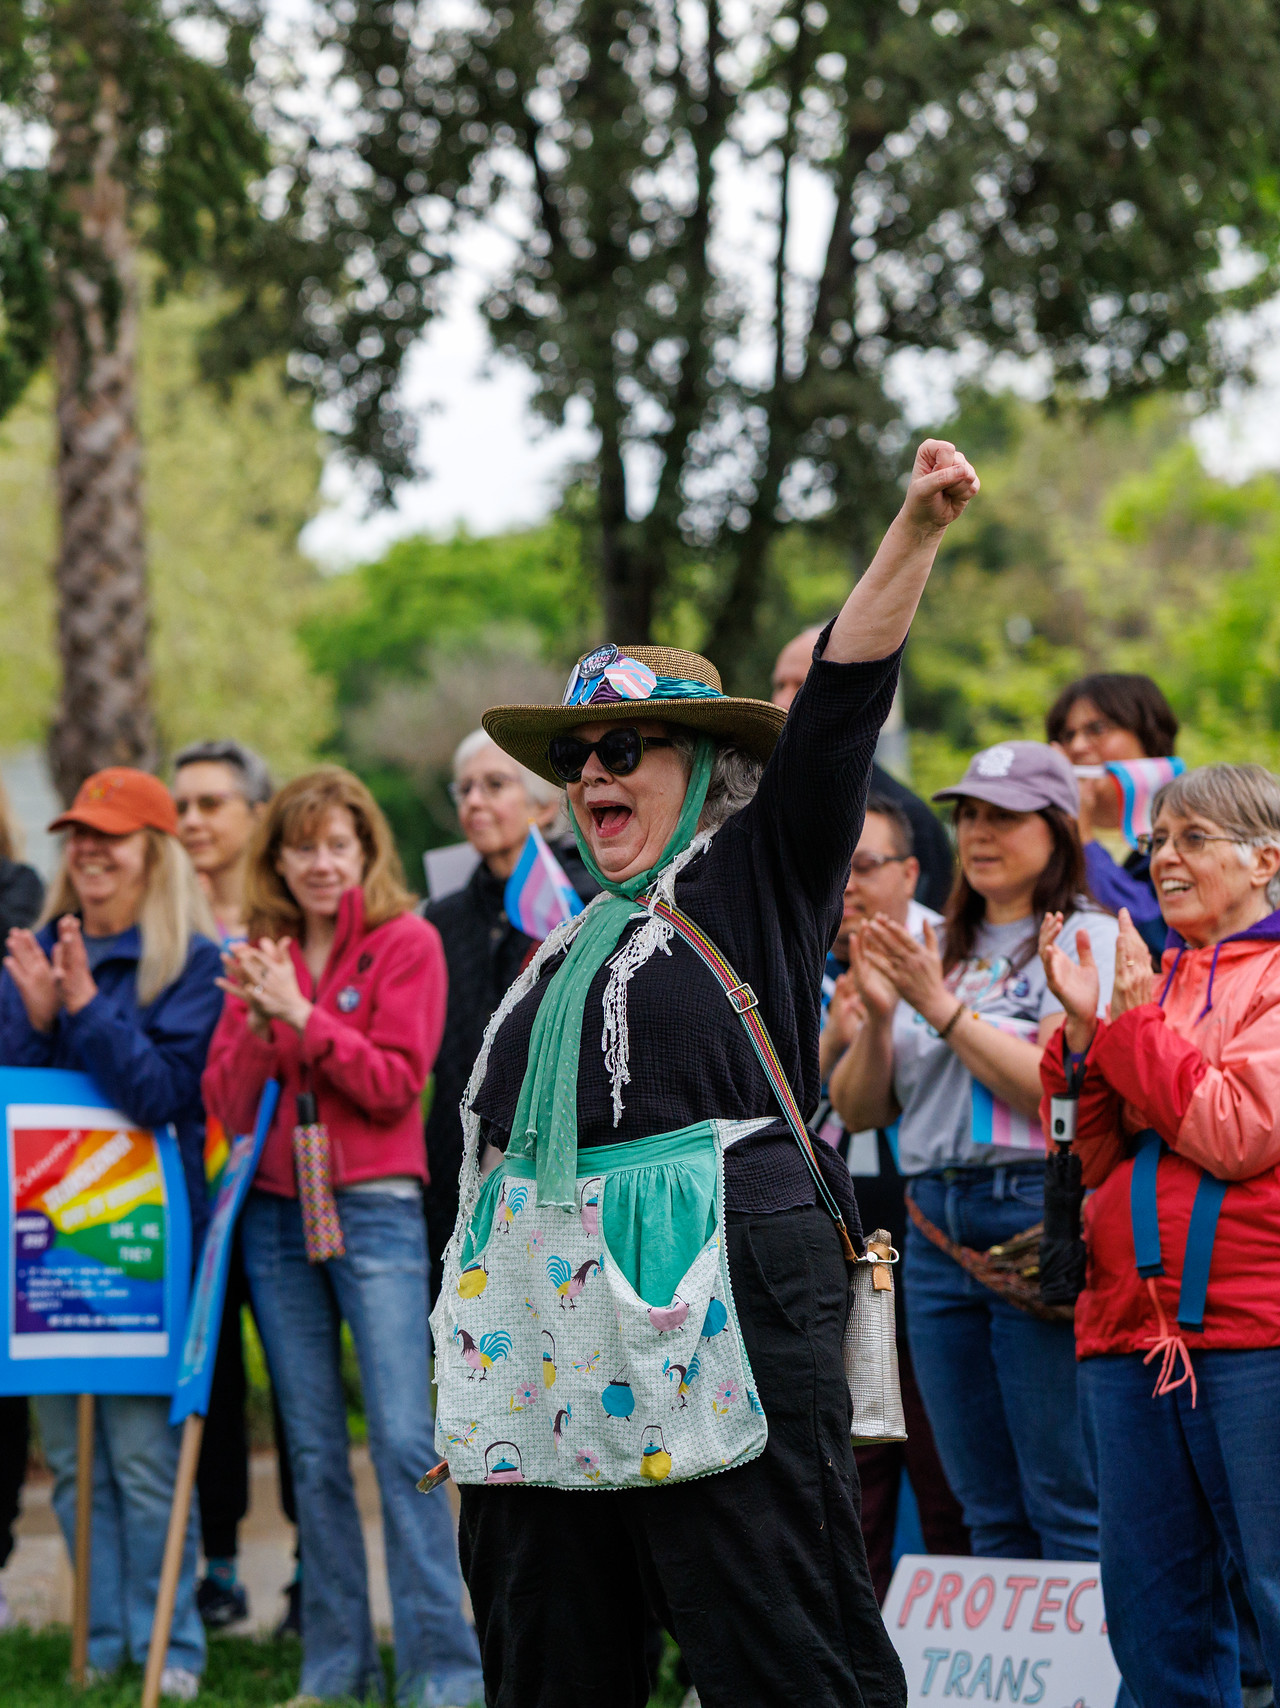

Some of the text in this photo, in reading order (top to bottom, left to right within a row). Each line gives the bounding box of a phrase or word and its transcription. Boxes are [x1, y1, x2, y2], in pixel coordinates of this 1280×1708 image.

[583, 655, 611, 668] TRANS
[585, 662, 607, 674] LIVES
[897, 1569, 1108, 1634] PROTEC
[921, 1647, 1052, 1704] TRANS
